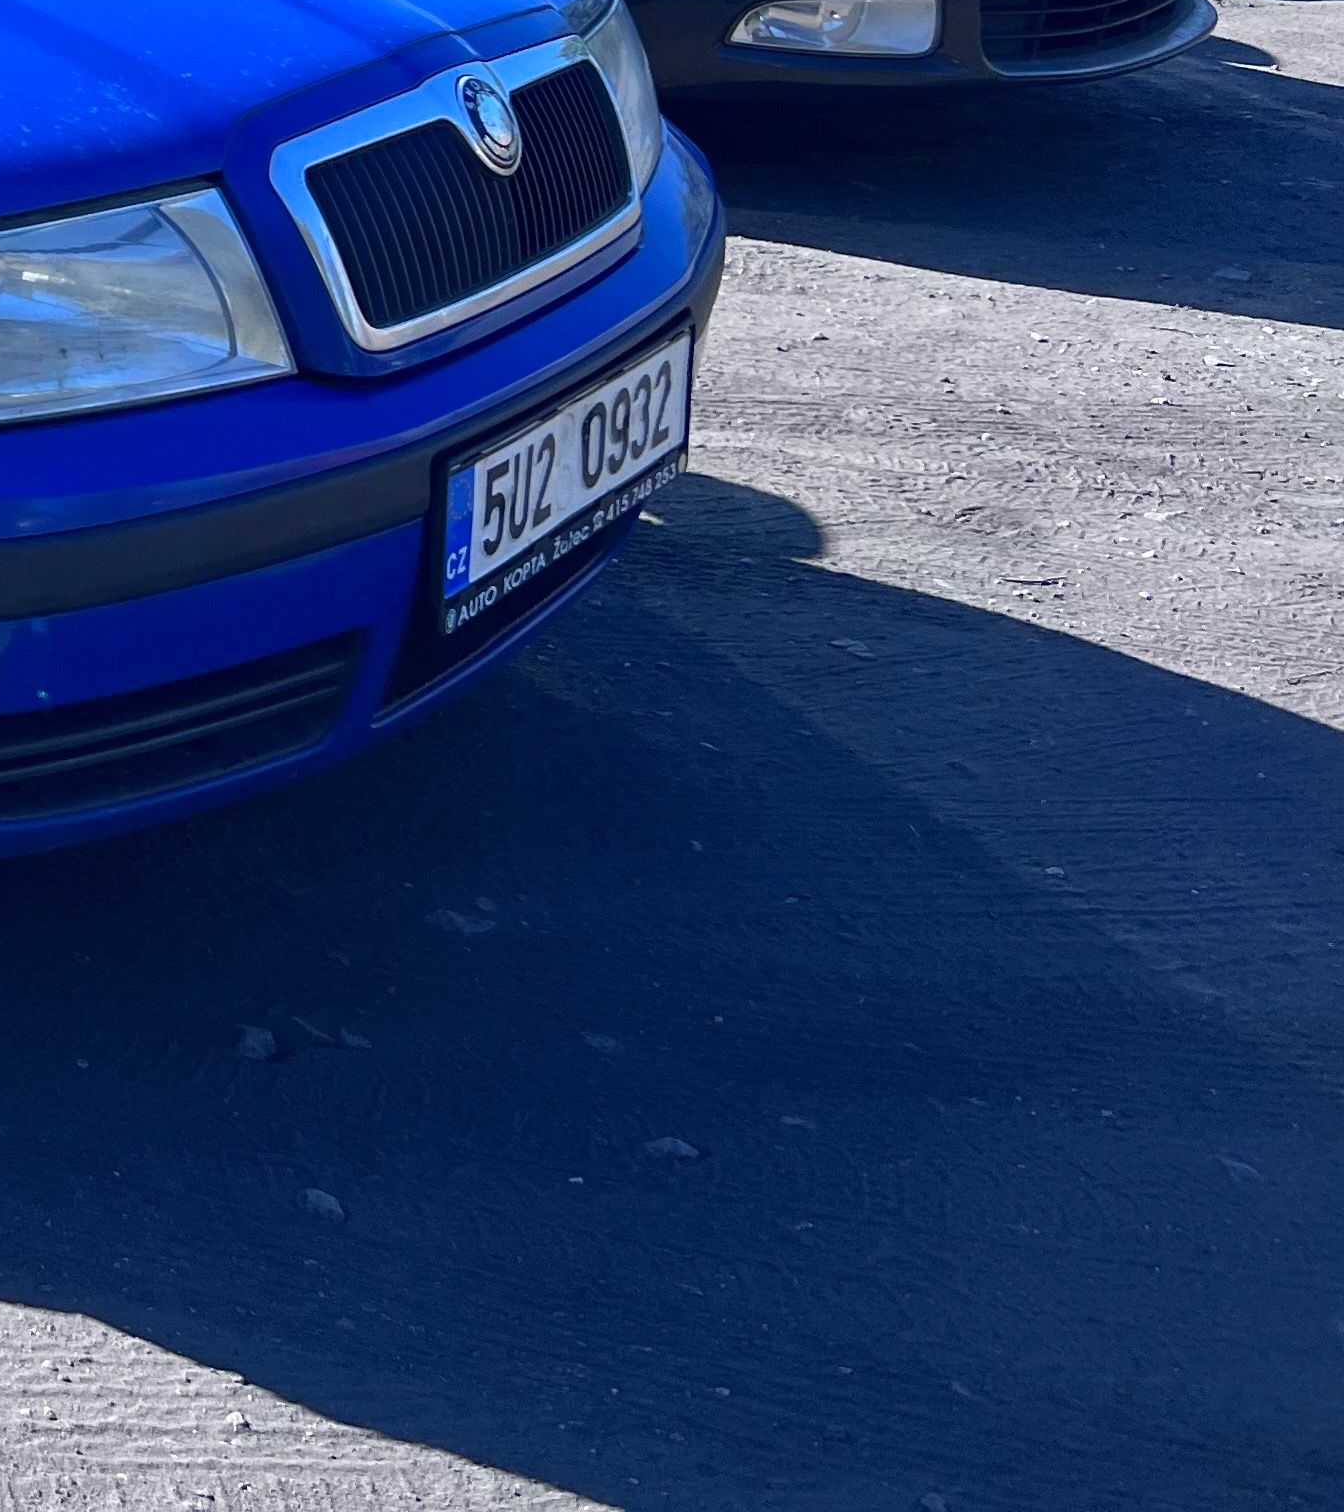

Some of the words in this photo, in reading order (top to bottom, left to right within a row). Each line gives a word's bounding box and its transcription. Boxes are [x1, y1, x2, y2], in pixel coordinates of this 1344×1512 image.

[483, 432, 555, 557] 5U2
[581, 360, 672, 489] 0932
[446, 545, 468, 580] CZ
[458, 585, 498, 626] AUTO
[503, 552, 546, 595] KOPTA
